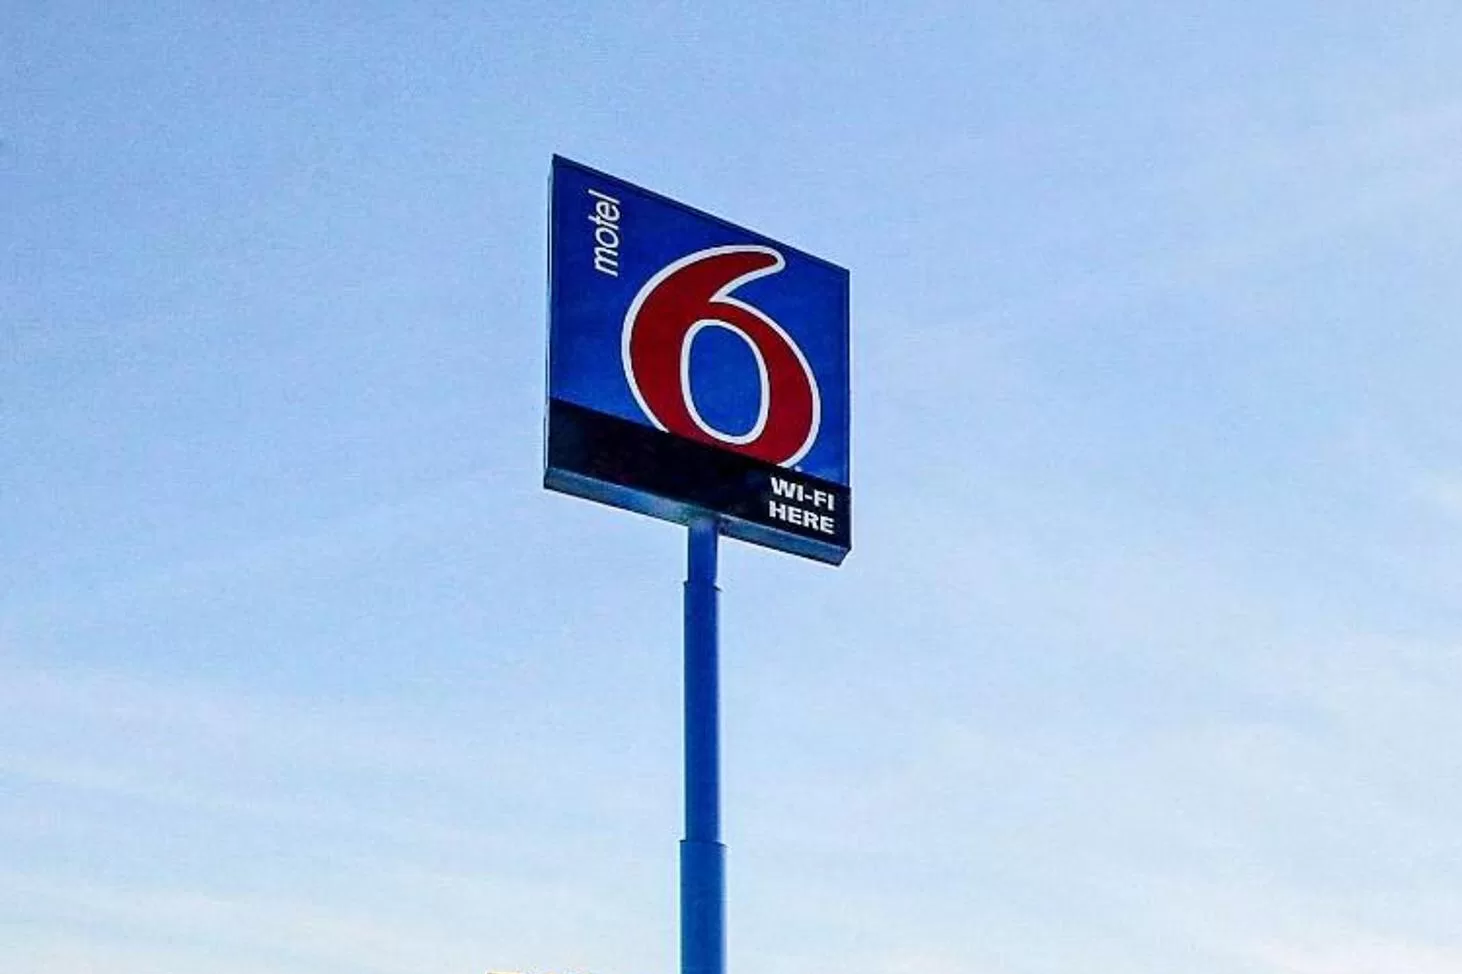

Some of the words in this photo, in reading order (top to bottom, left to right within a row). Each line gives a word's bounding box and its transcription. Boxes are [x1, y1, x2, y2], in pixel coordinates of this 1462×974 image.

[588, 189, 620, 277] motel
[621, 245, 821, 468] 6
[769, 501, 835, 535] HERE
[770, 477, 835, 511] WI-FI
